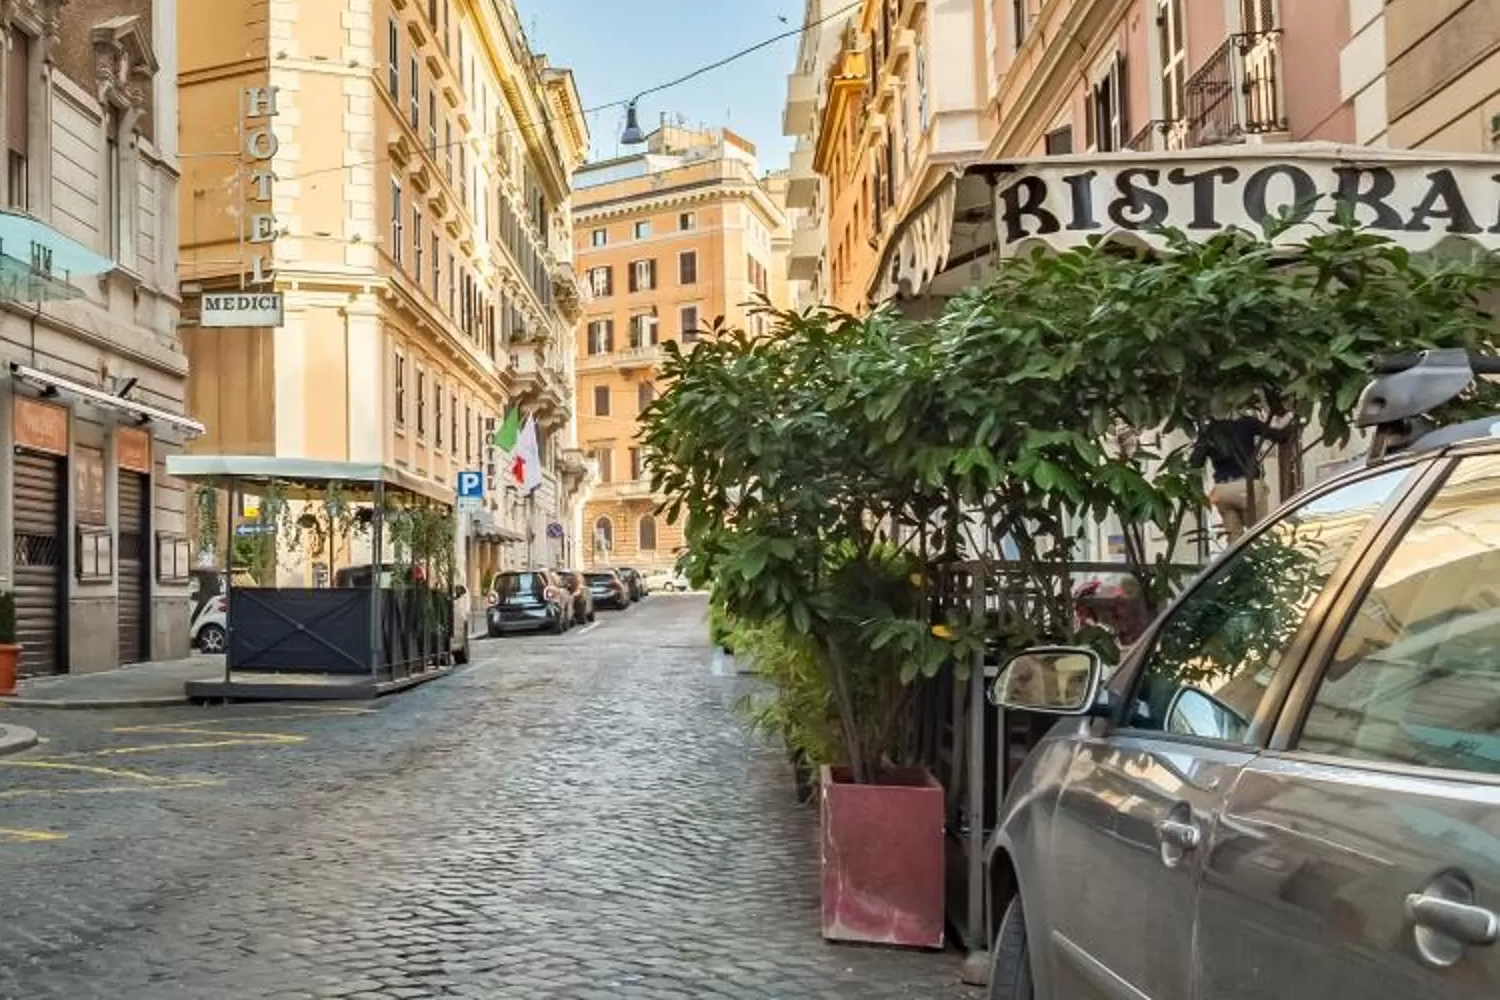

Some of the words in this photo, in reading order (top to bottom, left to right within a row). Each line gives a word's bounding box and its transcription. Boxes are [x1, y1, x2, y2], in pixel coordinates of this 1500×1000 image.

[245, 85, 280, 284] HOTEL
[1000, 164, 1500, 244] RISTORA
[205, 296, 278, 311] MEDICI
[461, 474, 479, 494] P
